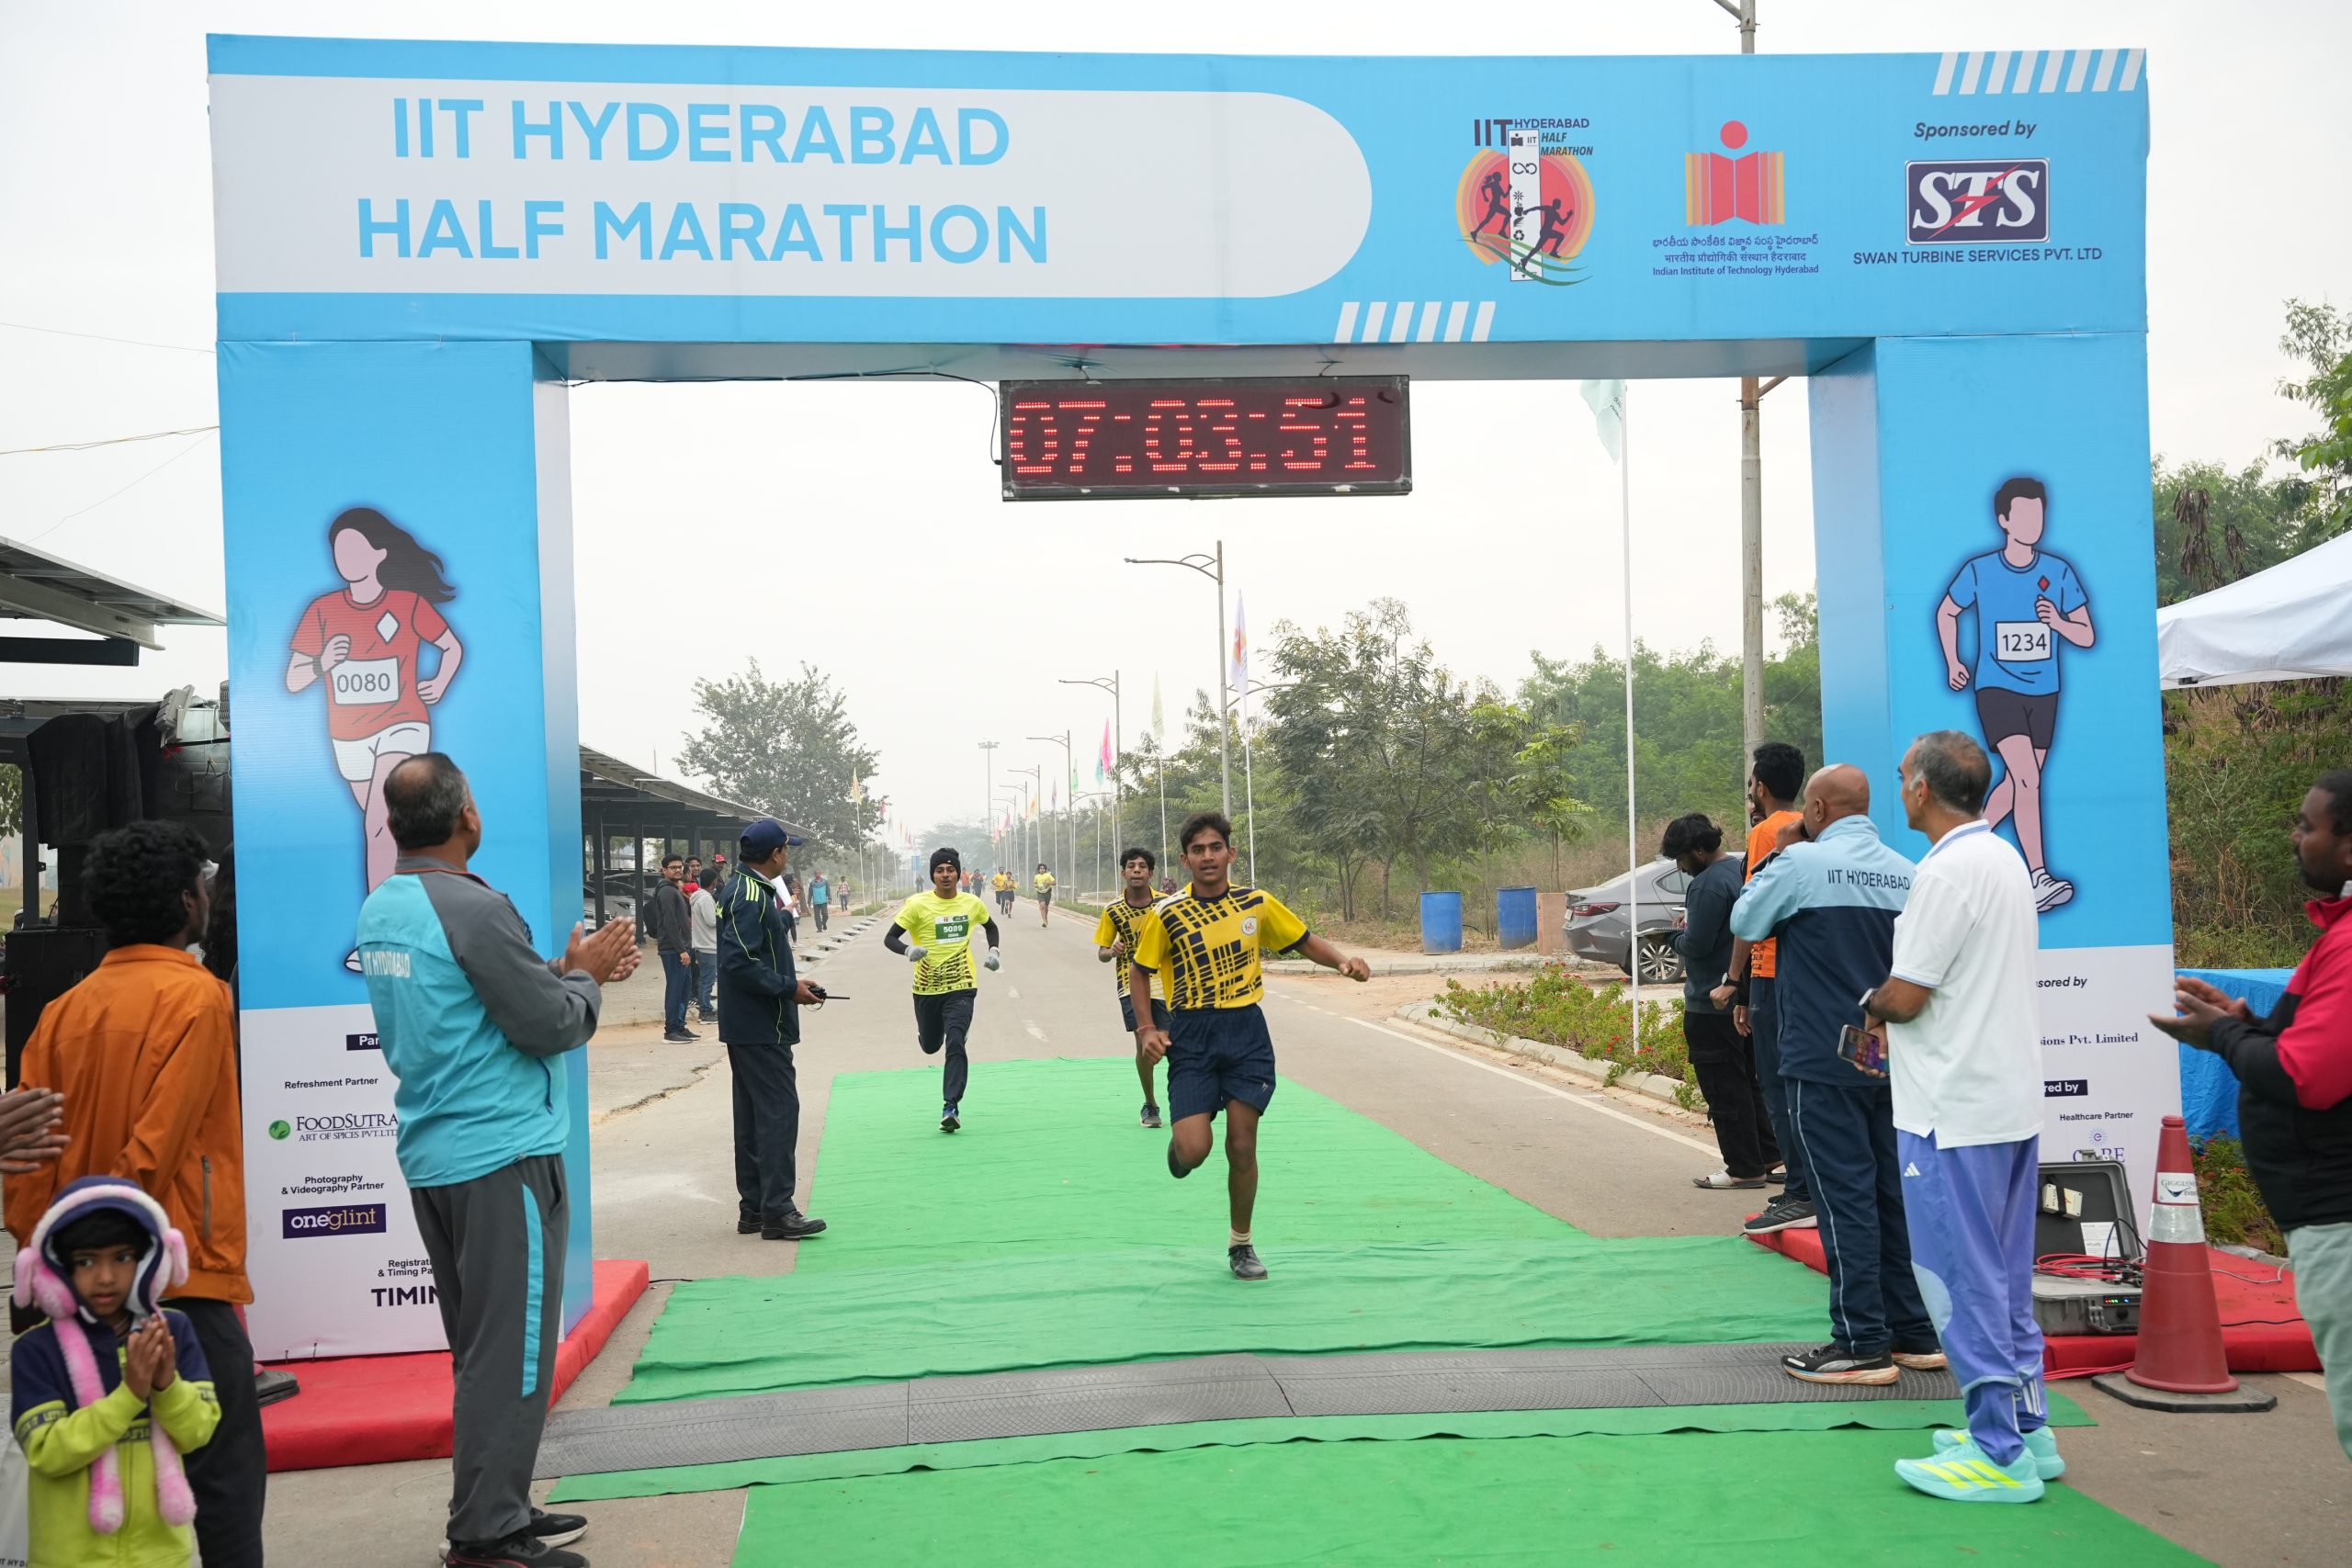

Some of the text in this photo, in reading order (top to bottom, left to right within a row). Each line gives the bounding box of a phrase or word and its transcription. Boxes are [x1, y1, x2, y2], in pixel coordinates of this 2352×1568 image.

[392, 97, 1010, 165] IIT HYDERABAD
[1475, 118, 1589, 146] IIT HYDERABAD
[1541, 132, 1567, 142] HALF
[1914, 120, 2037, 141] Sponsored by
[1540, 146, 1593, 156] MARATHON
[1913, 170, 2040, 229] STS
[357, 197, 1047, 265] HALF MARATHON
[1665, 251, 1695, 263] भारतीय
[1853, 247, 2102, 265] SWAN TURBINE SERVICES PVT. LTD
[1653, 265, 1819, 276] Indian Institute of Technology Hyderabad
[1010, 399, 1375, 473] 07:03:51
[2002, 633, 2047, 652] 1234
[336, 672, 390, 694] 0080
[1827, 869, 1910, 890] IIT HYDERABAD
[2036, 976, 2087, 988] sored by
[2069, 1034, 2092, 1045] Pvt.
[2096, 1032, 2139, 1043] Limited
[285, 1077, 379, 1089] Refreshment Partner
[2064, 1082, 2079, 1094] by
[2060, 1111, 2133, 1122] Healthcare Partner
[299, 1134, 317, 1142] ART
[320, 1133, 331, 1141] OF
[334, 1131, 359, 1139] SPICES
[2073, 1147, 2126, 1163] CRE
[305, 1174, 363, 1185] Photography
[290, 1183, 348, 1194] Videography
[351, 1182, 384, 1190] Partner
[291, 1208, 376, 1230] oneglint
[388, 1268, 418, 1277] Timing
